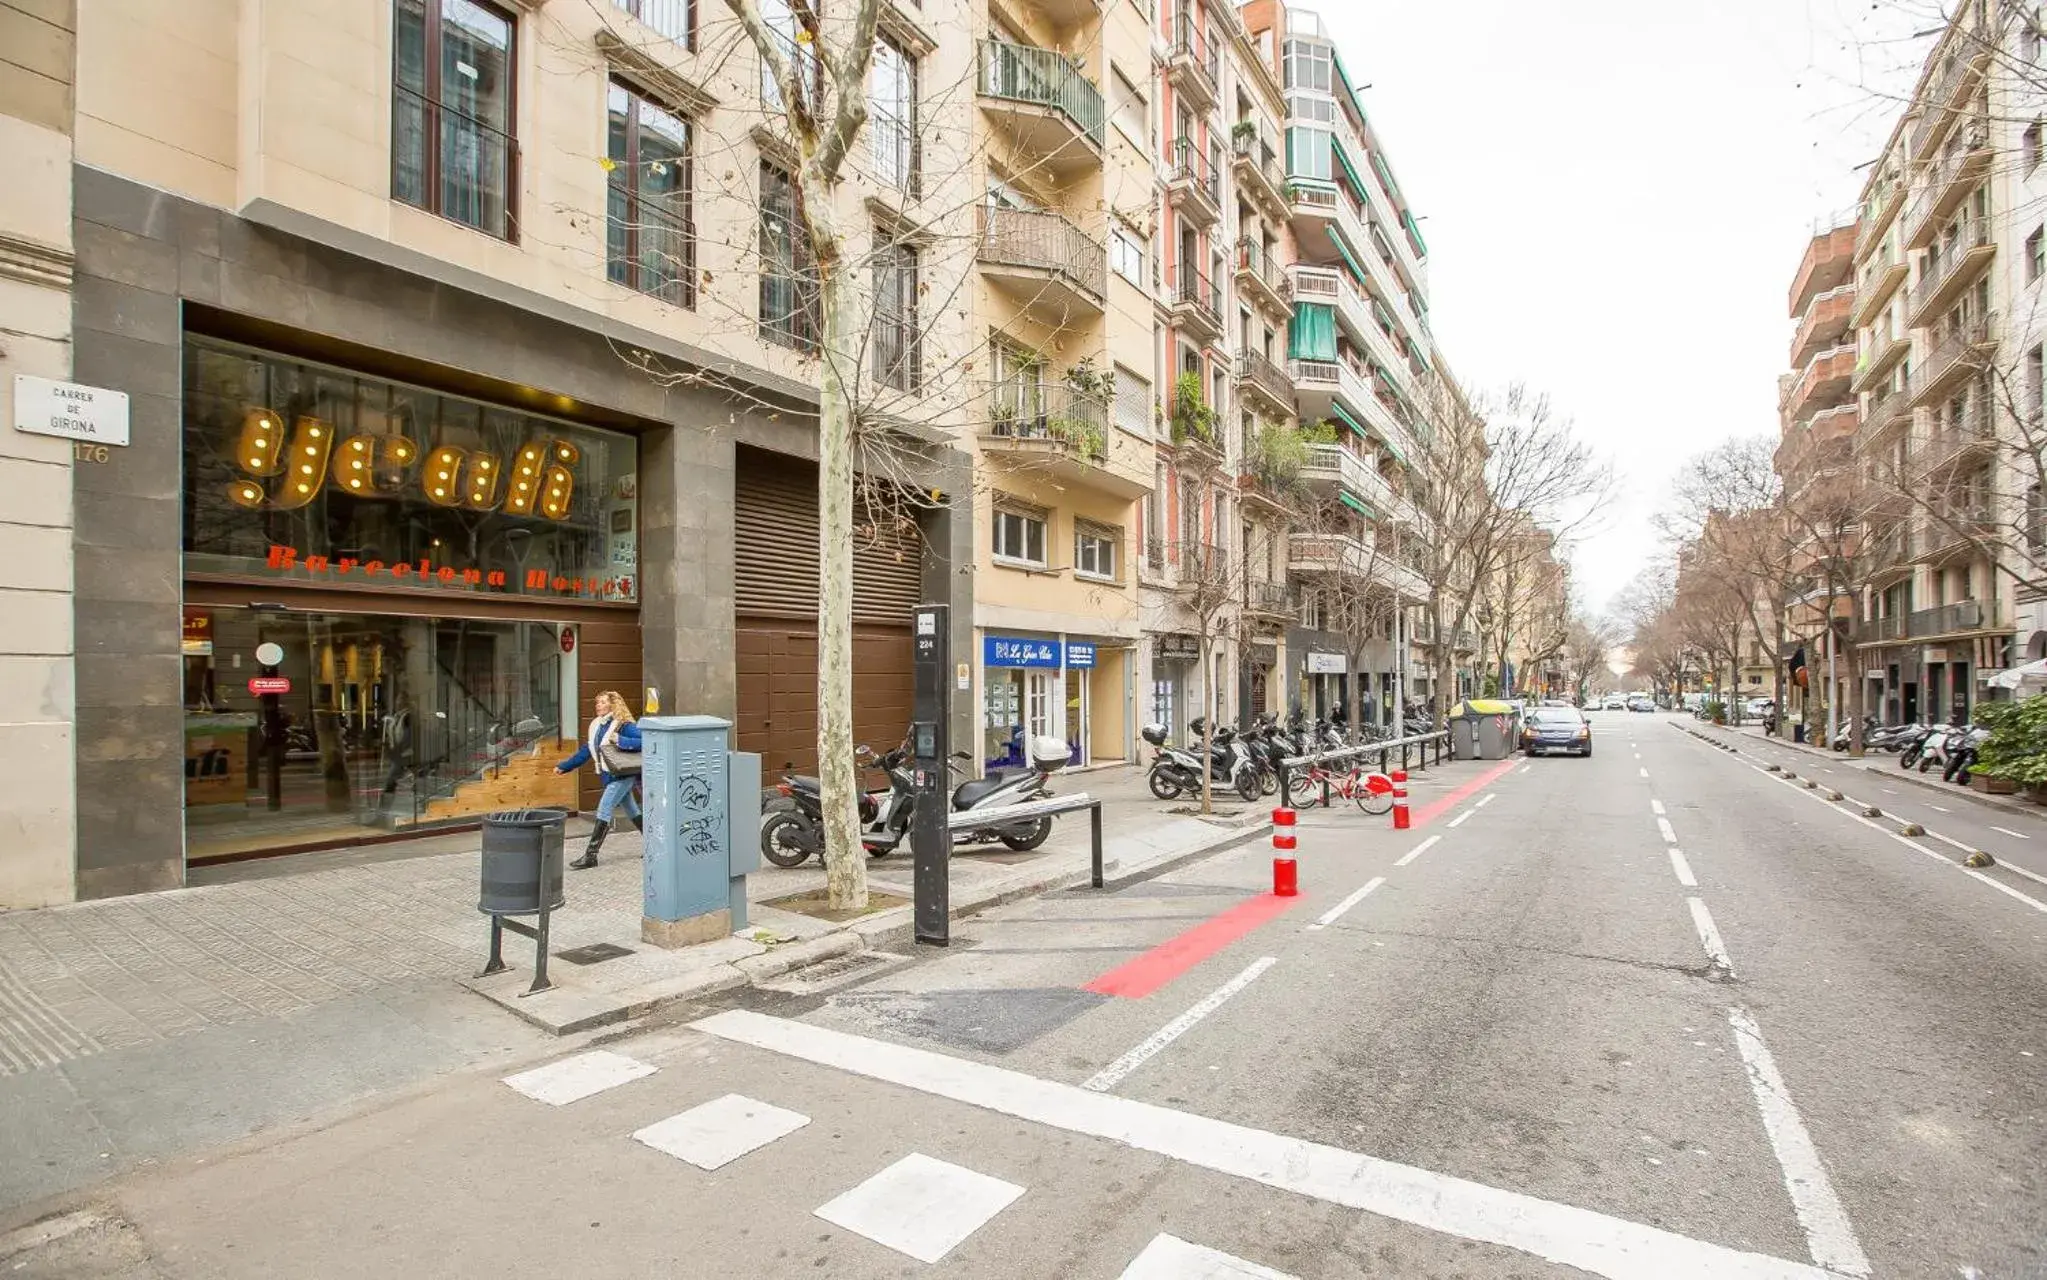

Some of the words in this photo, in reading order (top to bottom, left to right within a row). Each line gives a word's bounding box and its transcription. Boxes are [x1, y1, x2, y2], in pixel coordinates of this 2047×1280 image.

[53, 387, 94, 402] CARRER
[67, 405, 81, 414] DE
[50, 417, 97, 434] GIRONA
[73, 443, 109, 464] 176
[267, 544, 506, 587] Barcelona
[919, 640, 933, 649] 224
